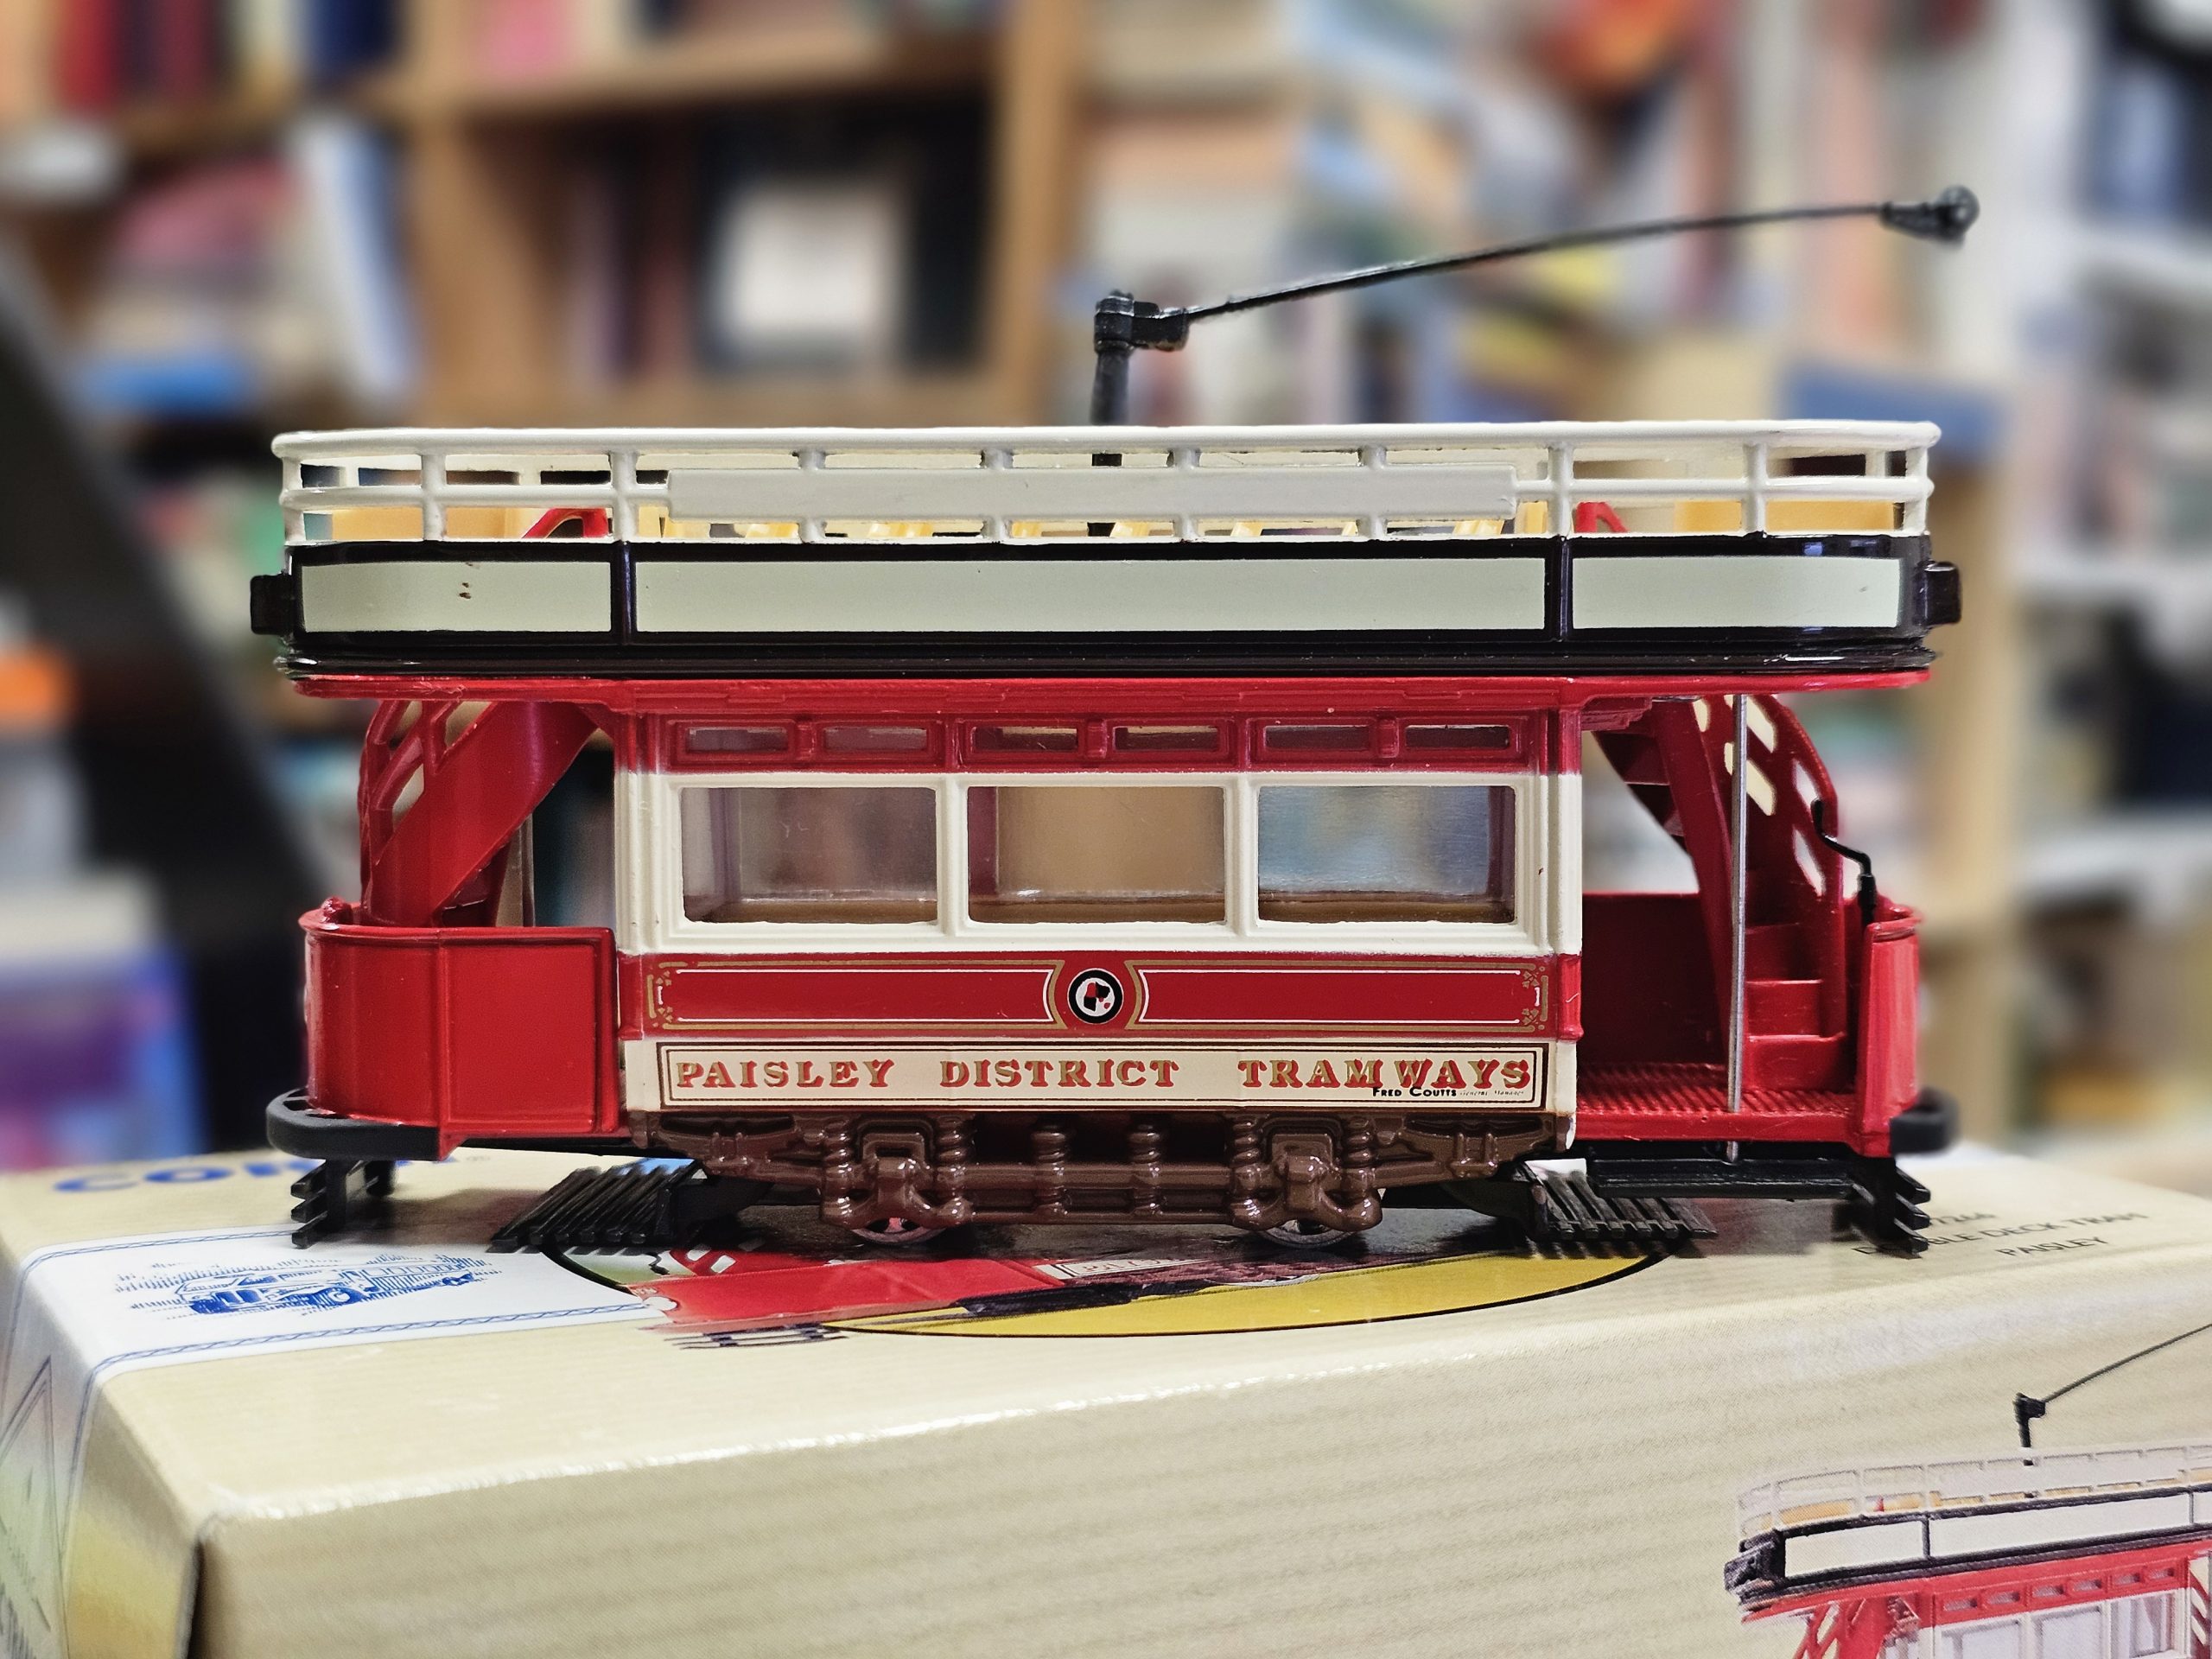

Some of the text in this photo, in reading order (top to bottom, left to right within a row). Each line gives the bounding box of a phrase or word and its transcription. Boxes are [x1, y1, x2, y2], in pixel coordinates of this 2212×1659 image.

[676, 1058, 1531, 1090] PAISLEY DISTRICT TRAMWAYS
[1851, 1211, 2149, 1255] DOBLE DECK TRAM
[1995, 1236, 2108, 1256] PAISLEY
